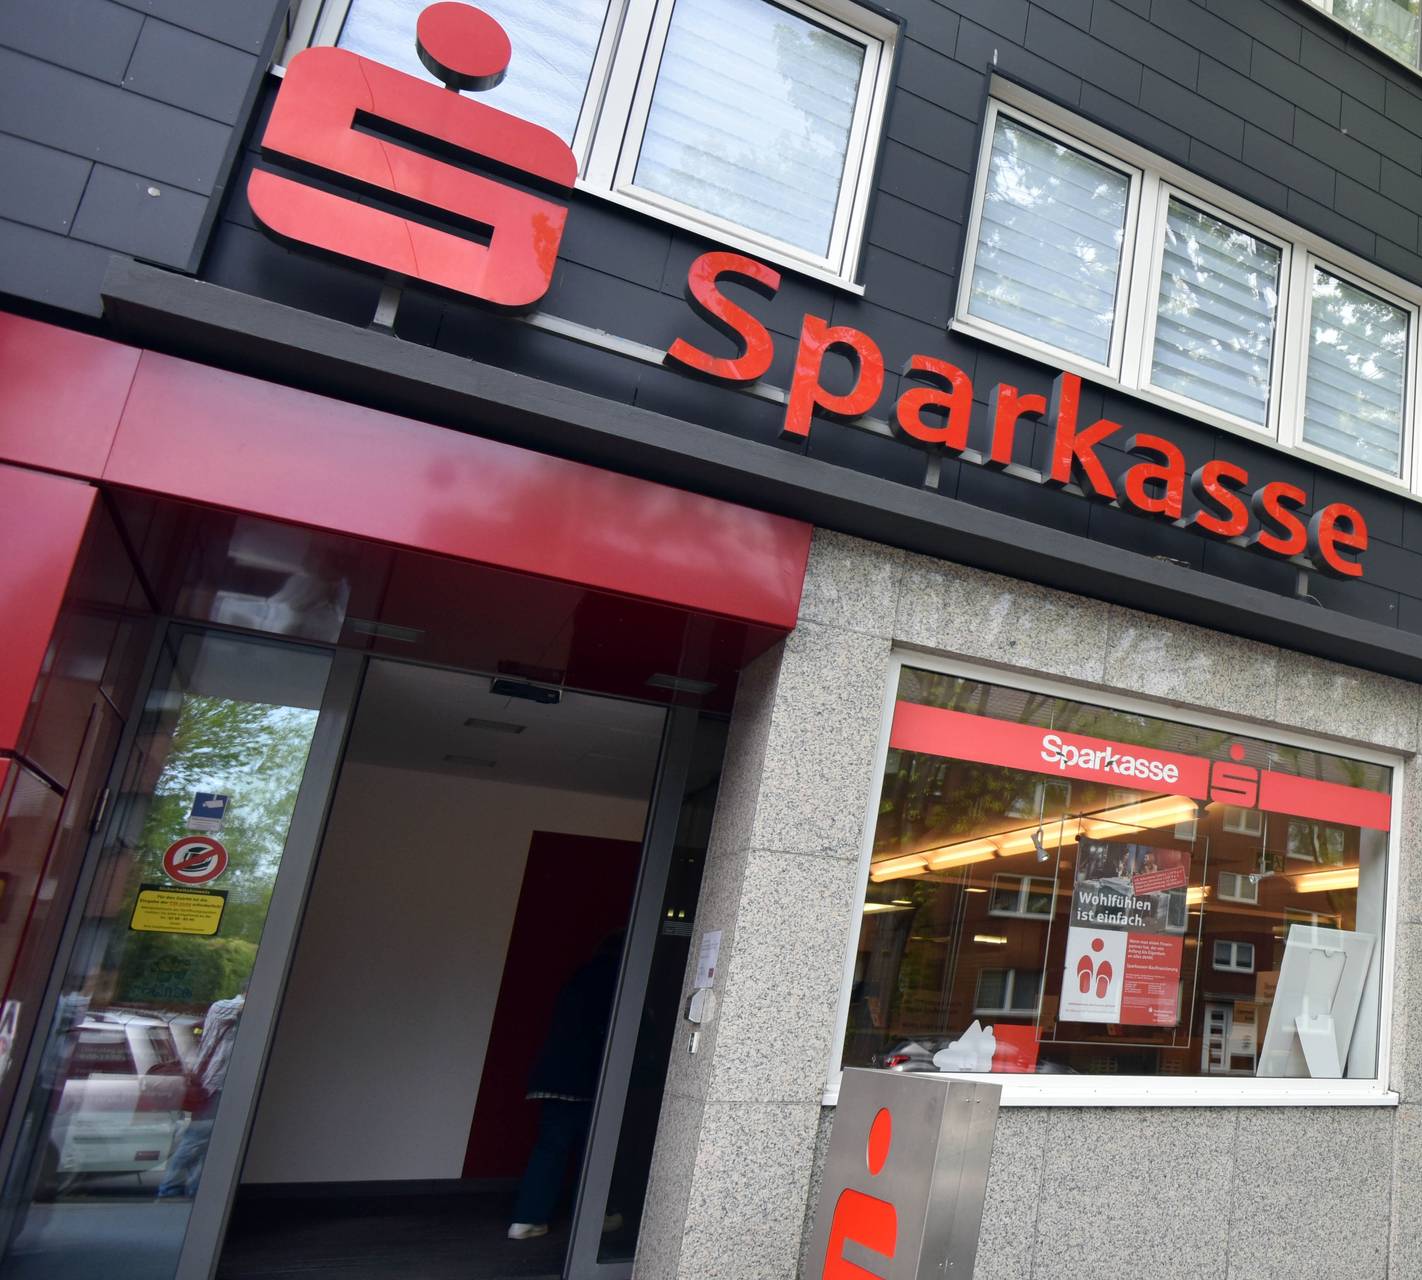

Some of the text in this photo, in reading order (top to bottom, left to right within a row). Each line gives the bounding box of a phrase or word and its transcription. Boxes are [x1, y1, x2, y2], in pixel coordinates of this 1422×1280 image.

[663, 251, 1370, 579] Sparkasse
[1041, 734, 1179, 784] Sparkasse
[1077, 908, 1146, 927] ist einfach.
[1079, 891, 1152, 911] Wohlfühlen
